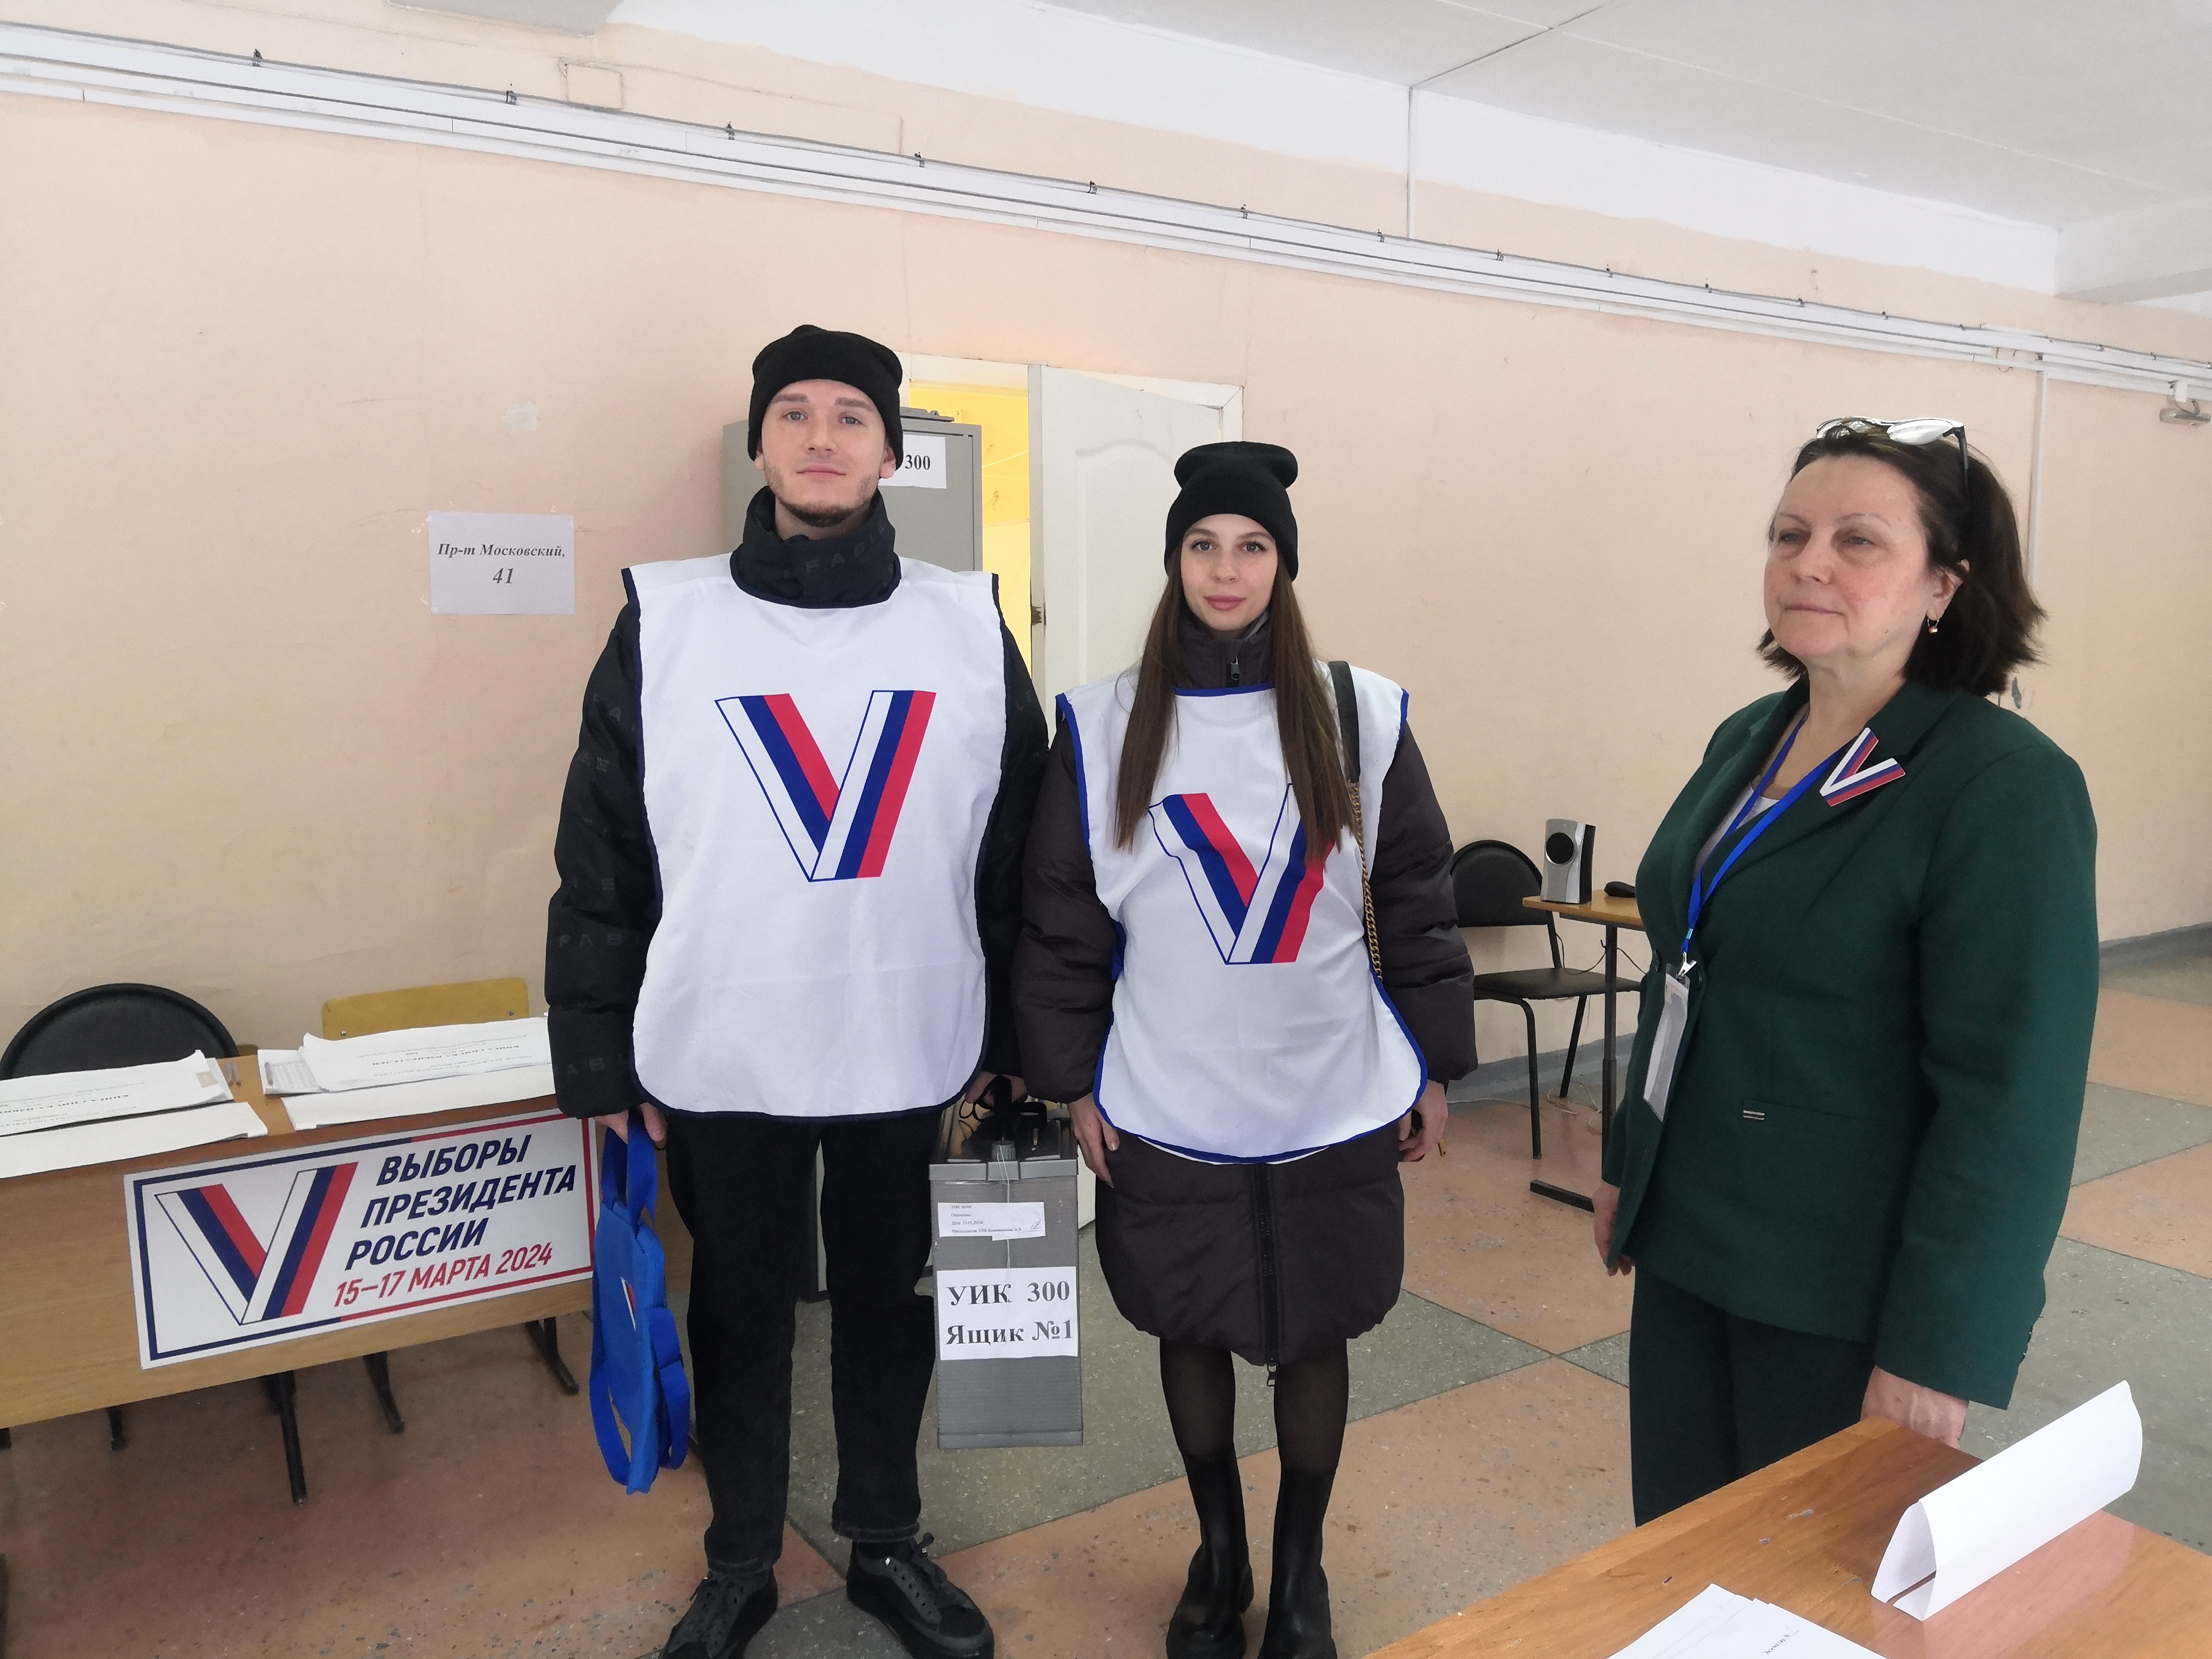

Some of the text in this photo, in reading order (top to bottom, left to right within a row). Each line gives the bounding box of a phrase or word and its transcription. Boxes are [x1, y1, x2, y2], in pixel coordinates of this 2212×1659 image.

[905, 455, 930, 470] 300
[438, 543, 565, 558] Пр-т Московский,
[493, 568, 514, 584] 41
[376, 1134, 532, 1186] ВЫБОРЫ
[361, 1165, 576, 1228] ПРЕЗИДЕНТА
[345, 1218, 489, 1271] РОССИИ
[407, 1253, 491, 1293] МАРТА
[495, 1242, 553, 1275] 2024
[946, 1281, 1070, 1306] УИК 300
[946, 1320, 1073, 1346] Ящик №1
